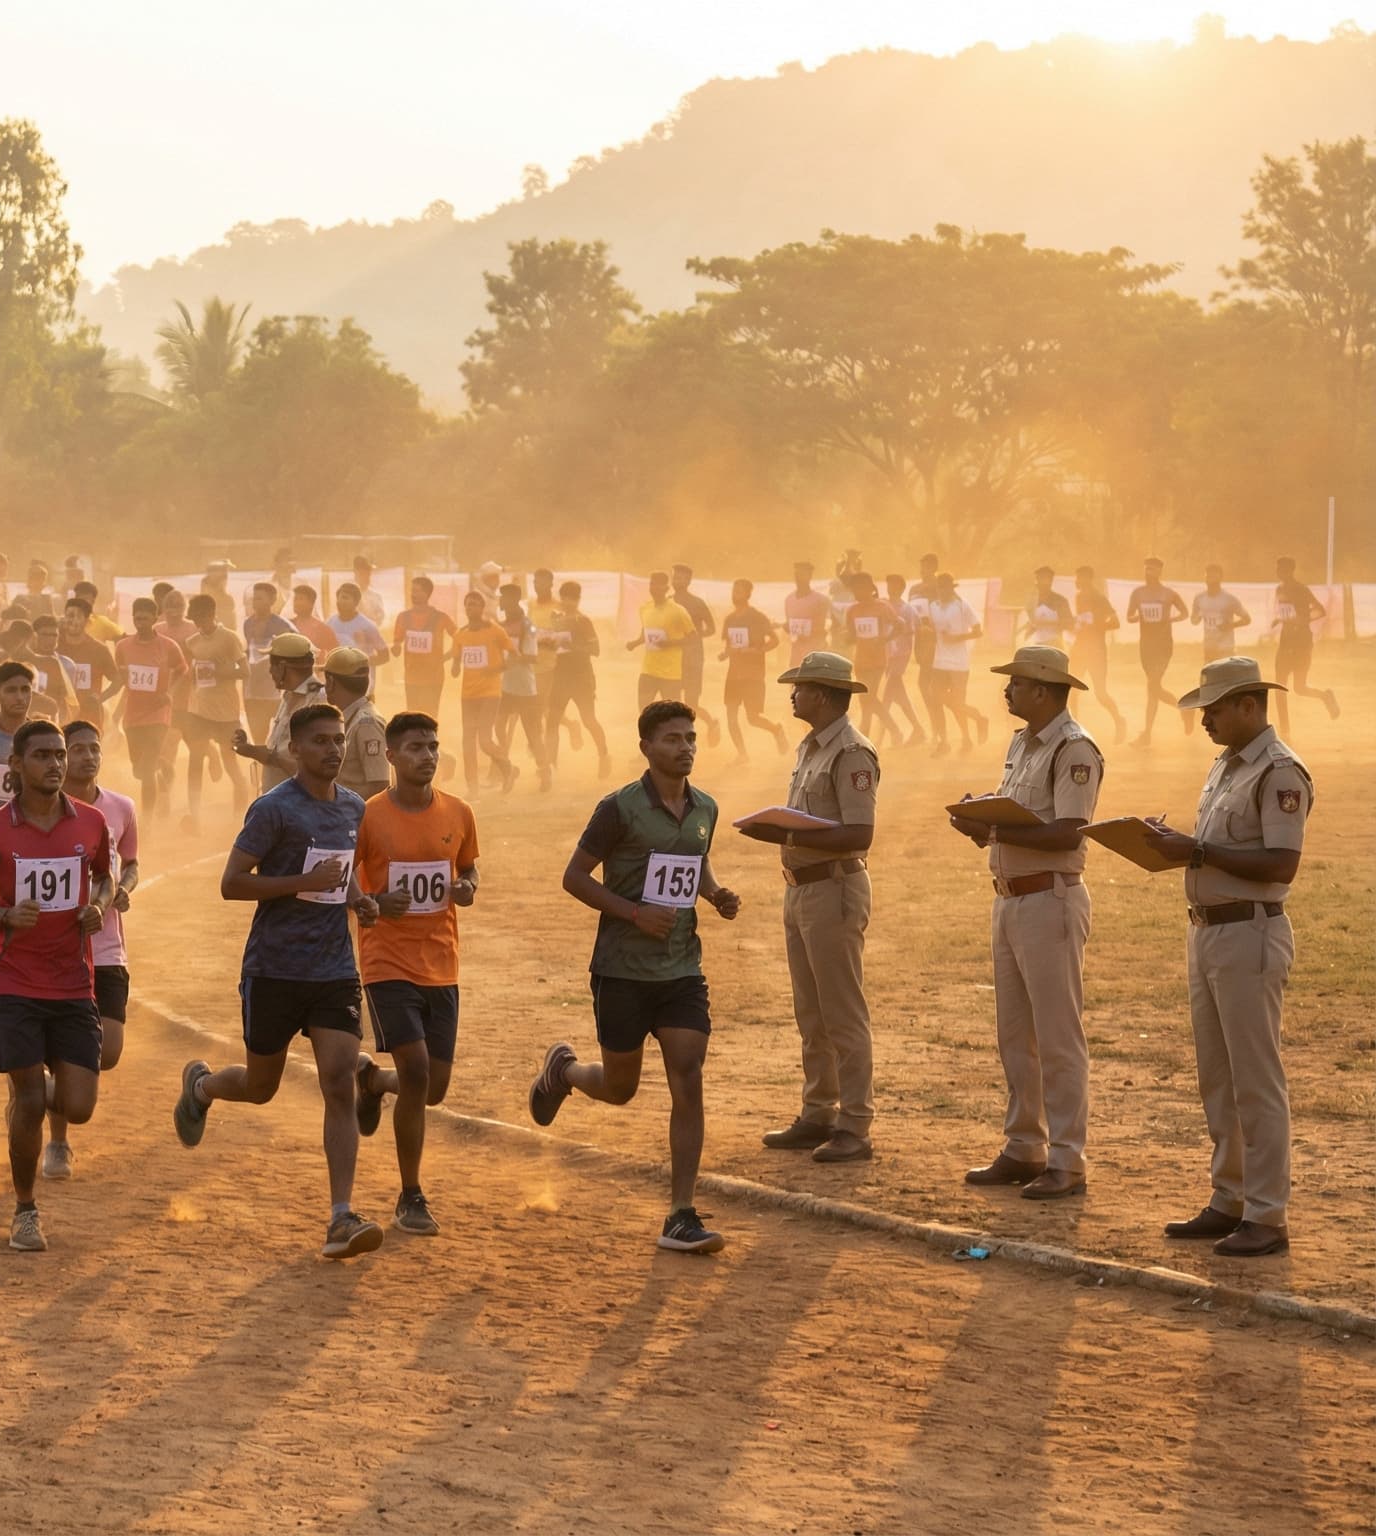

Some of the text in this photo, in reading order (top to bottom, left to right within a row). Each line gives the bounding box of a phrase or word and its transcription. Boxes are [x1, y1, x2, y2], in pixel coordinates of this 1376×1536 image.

[24, 868, 71, 902] 191
[396, 872, 445, 904] 106
[654, 865, 696, 898] 153
